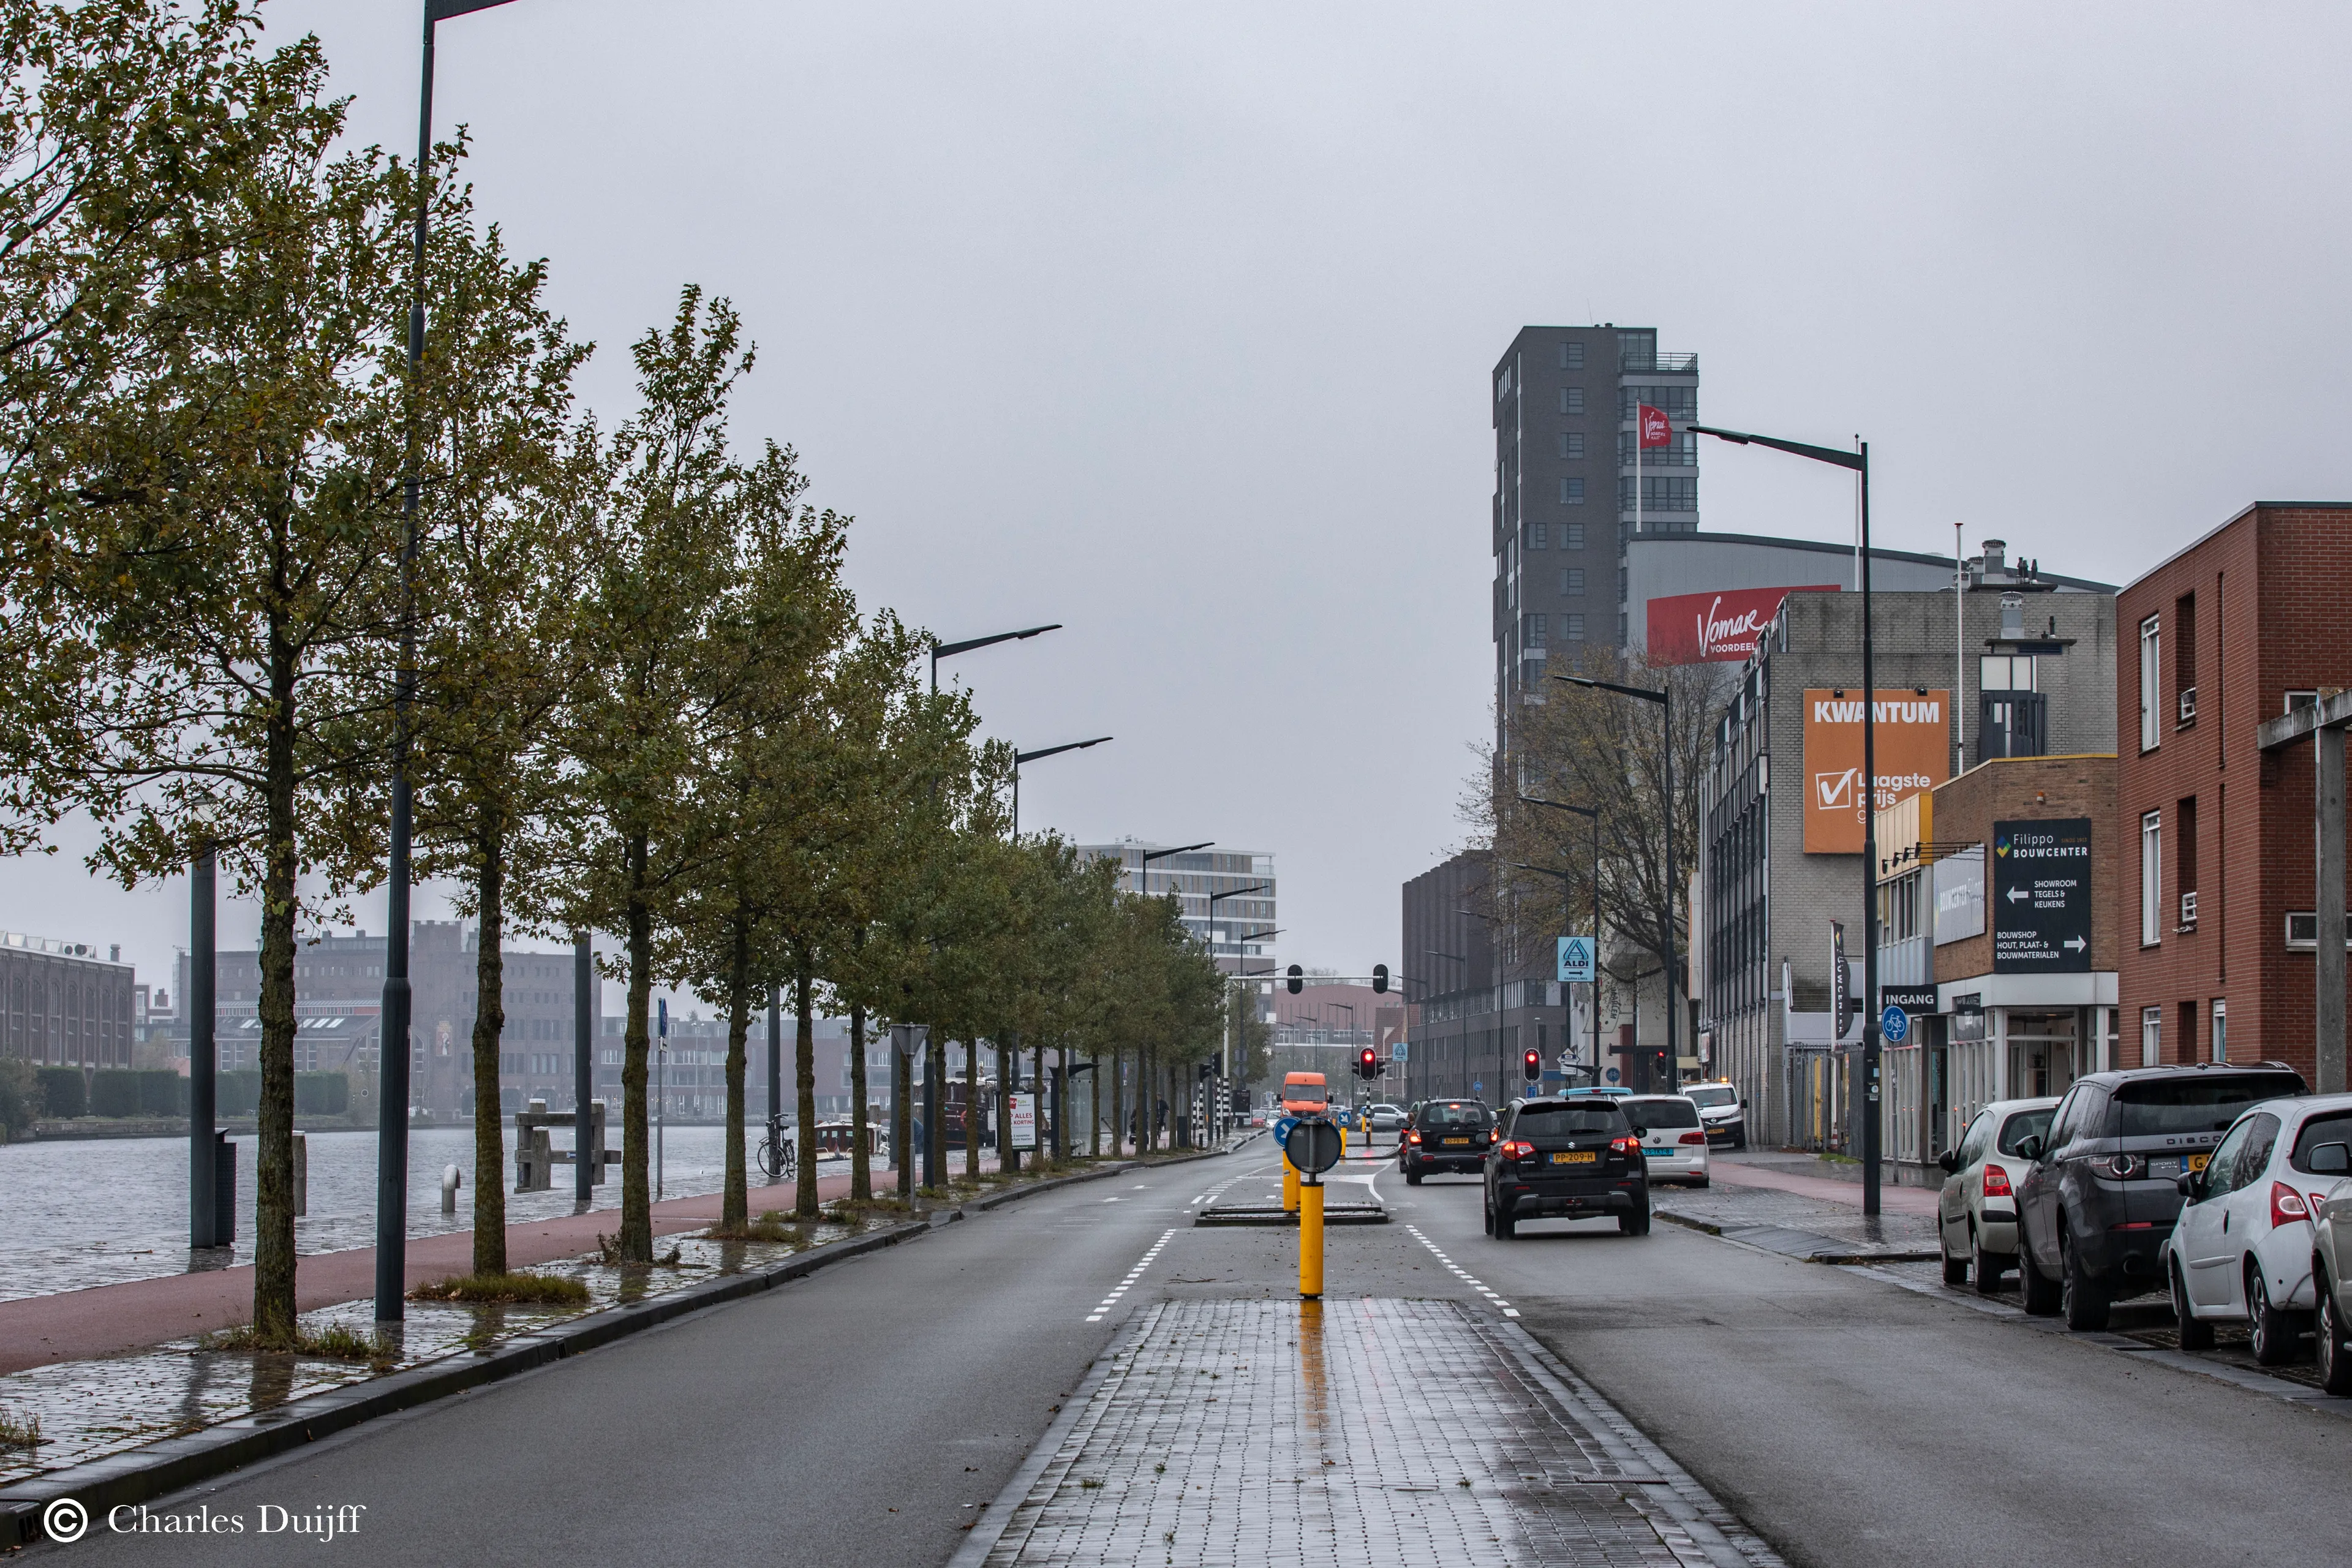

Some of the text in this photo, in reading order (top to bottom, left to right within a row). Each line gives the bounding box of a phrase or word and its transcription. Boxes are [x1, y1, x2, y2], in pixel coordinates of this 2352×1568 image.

[1697, 595, 1768, 658] Vomar
[1711, 642, 1756, 654] VOORDEEL
[1814, 701, 1939, 723] KWANTUM
[1857, 772, 1931, 792] Lagste
[2013, 834, 2054, 846] Filippo
[2013, 846, 2088, 858] BOUWCENTER
[2034, 880, 2077, 888] SHOWROOM
[1886, 994, 1934, 1005] INGANG
[2166, 1135, 2222, 1145] DISCO
[1555, 1152, 1593, 1161] PP-209-H
